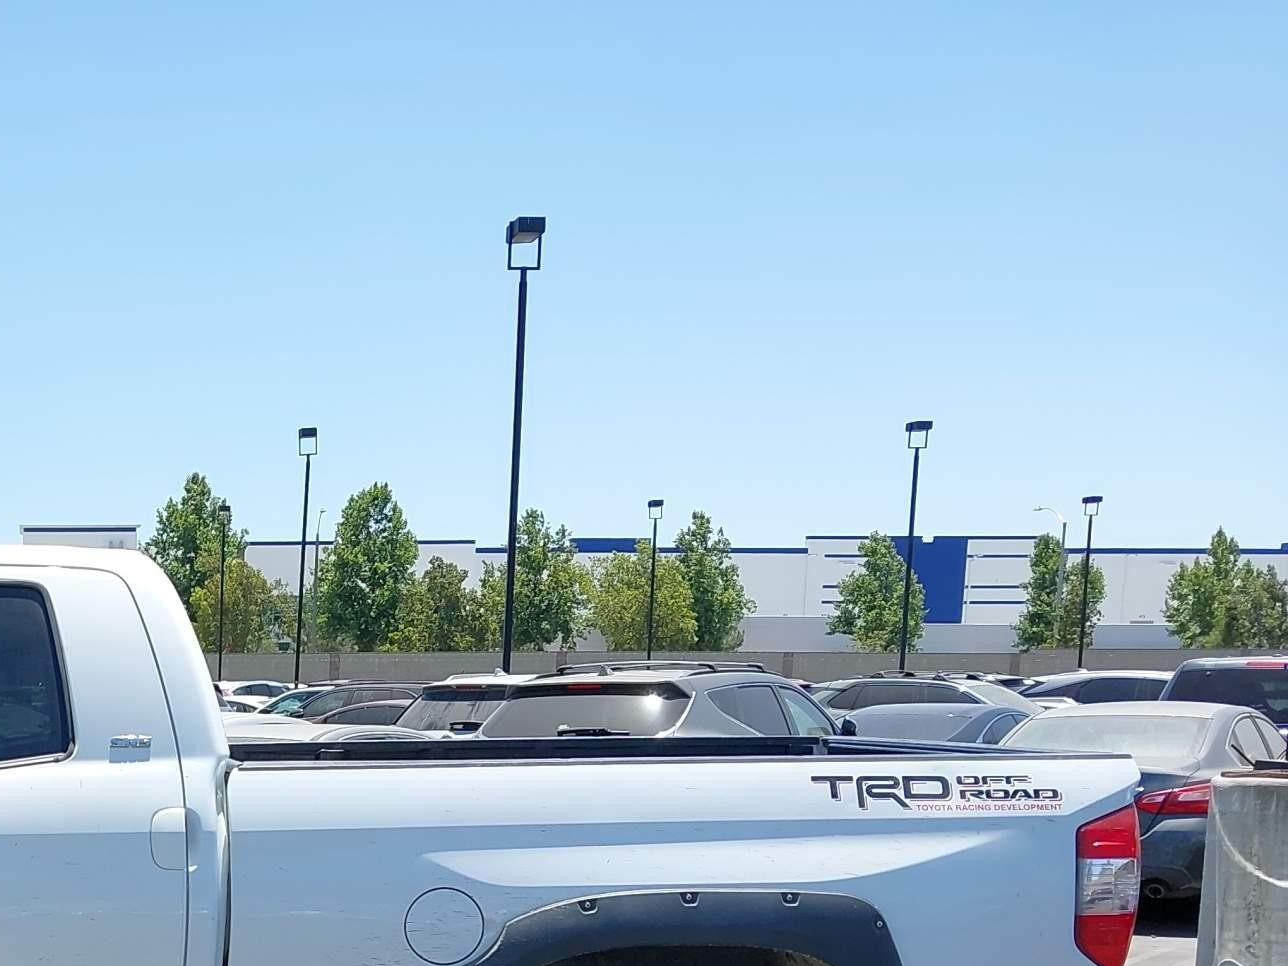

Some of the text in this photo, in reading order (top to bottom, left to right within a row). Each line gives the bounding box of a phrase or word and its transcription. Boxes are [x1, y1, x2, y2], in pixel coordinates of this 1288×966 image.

[956, 775, 1032, 787] OFF
[811, 775, 953, 811] TRD
[959, 789, 1063, 802] ROAD
[916, 803, 1063, 812] TOYOTA RACING DEVELOPMENT
